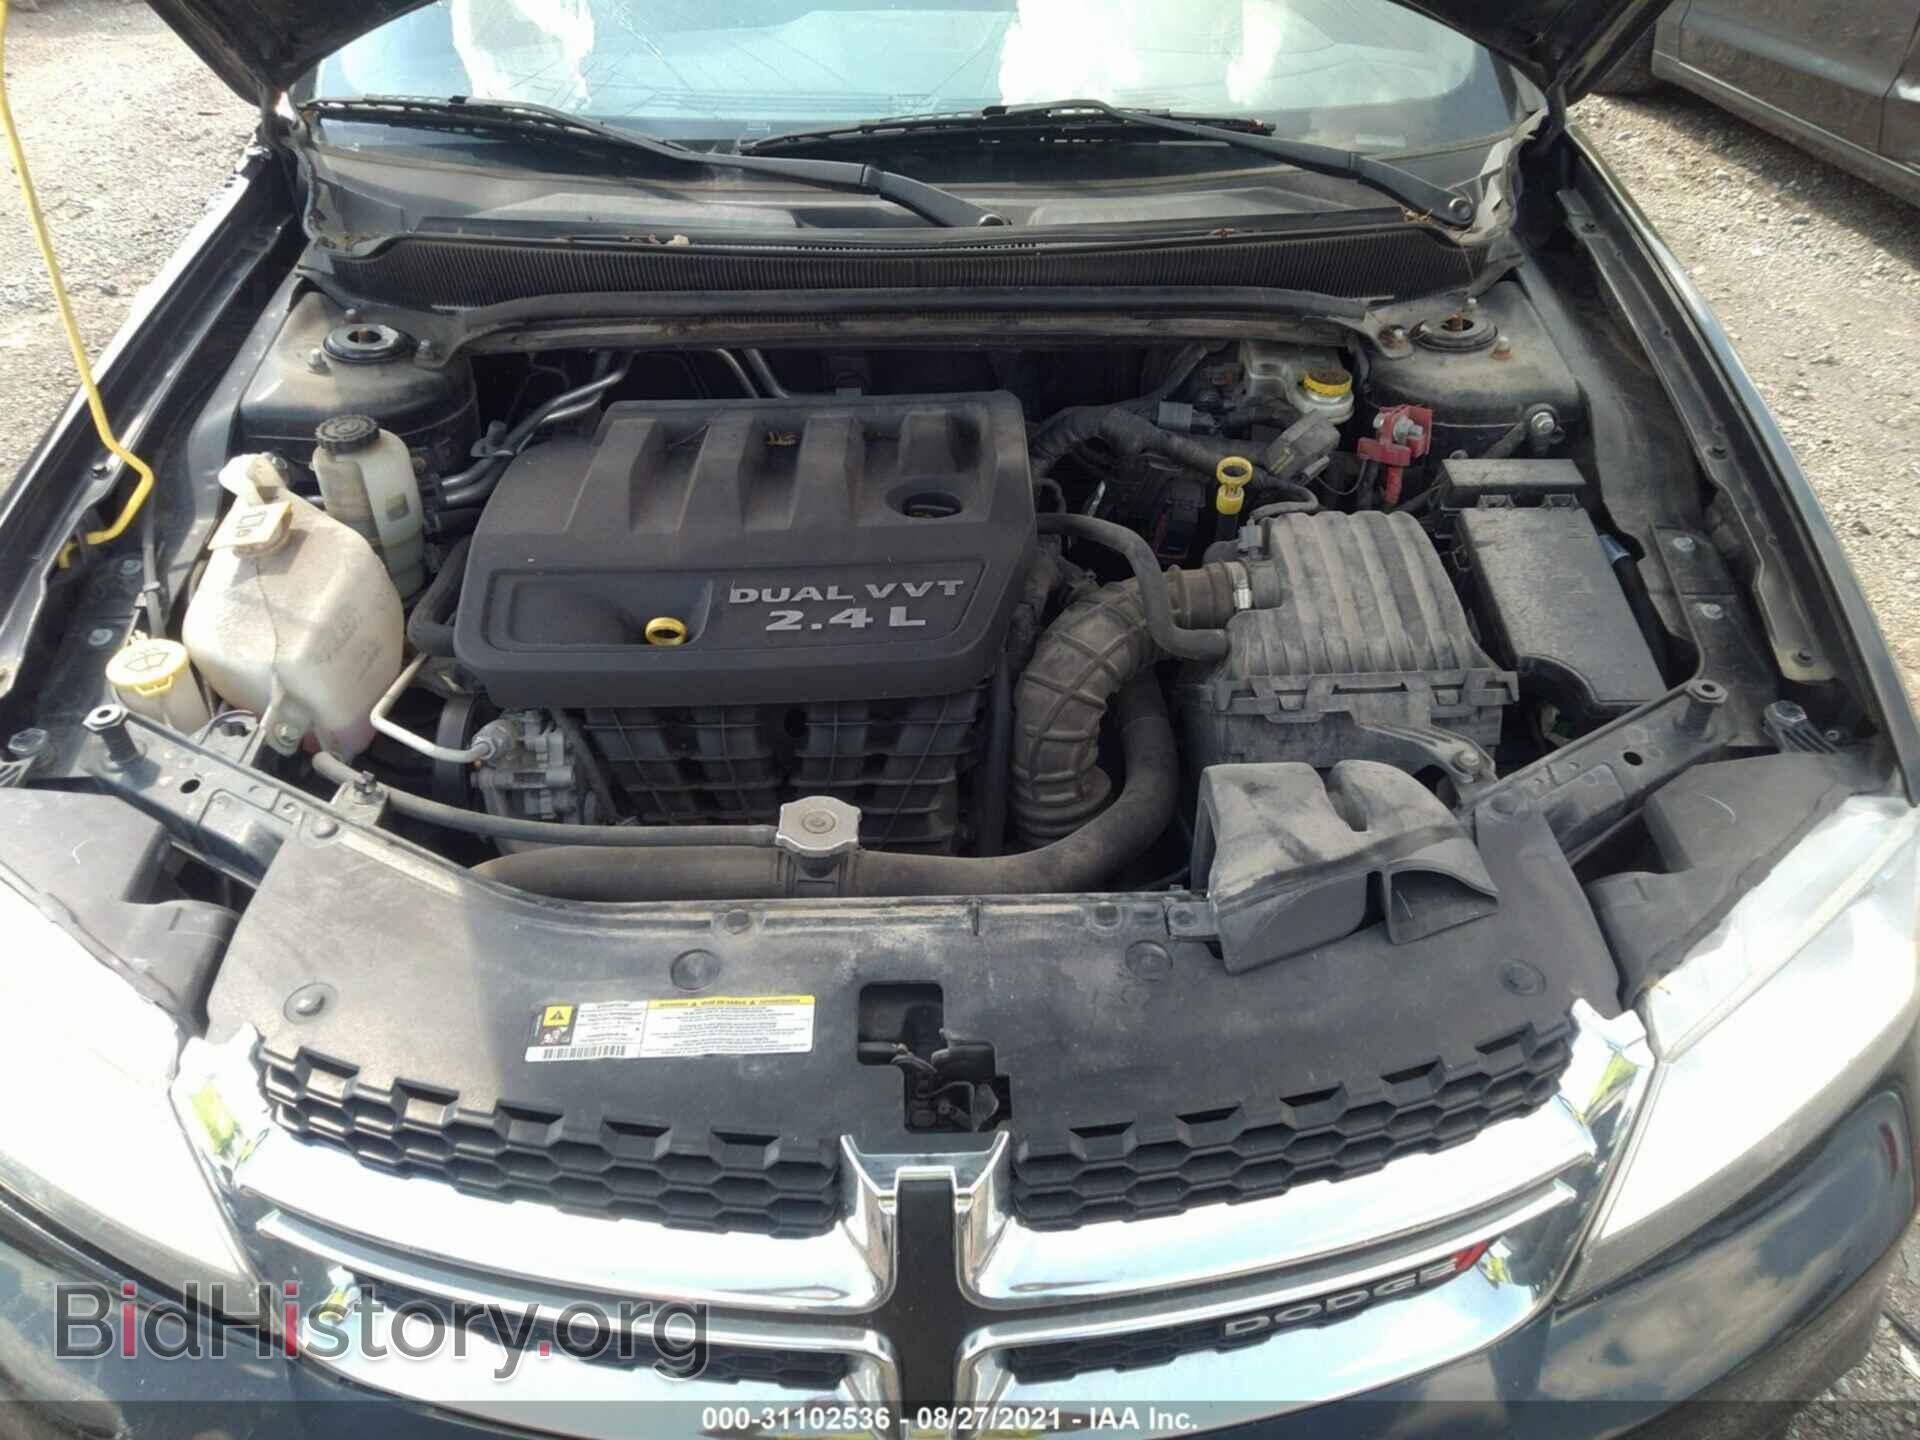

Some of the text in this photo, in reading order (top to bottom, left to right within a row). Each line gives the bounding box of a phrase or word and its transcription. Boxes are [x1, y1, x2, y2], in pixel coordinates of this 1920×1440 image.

[729, 580, 964, 604] DUAL VVT
[1224, 1258, 1457, 1337] DODGE
